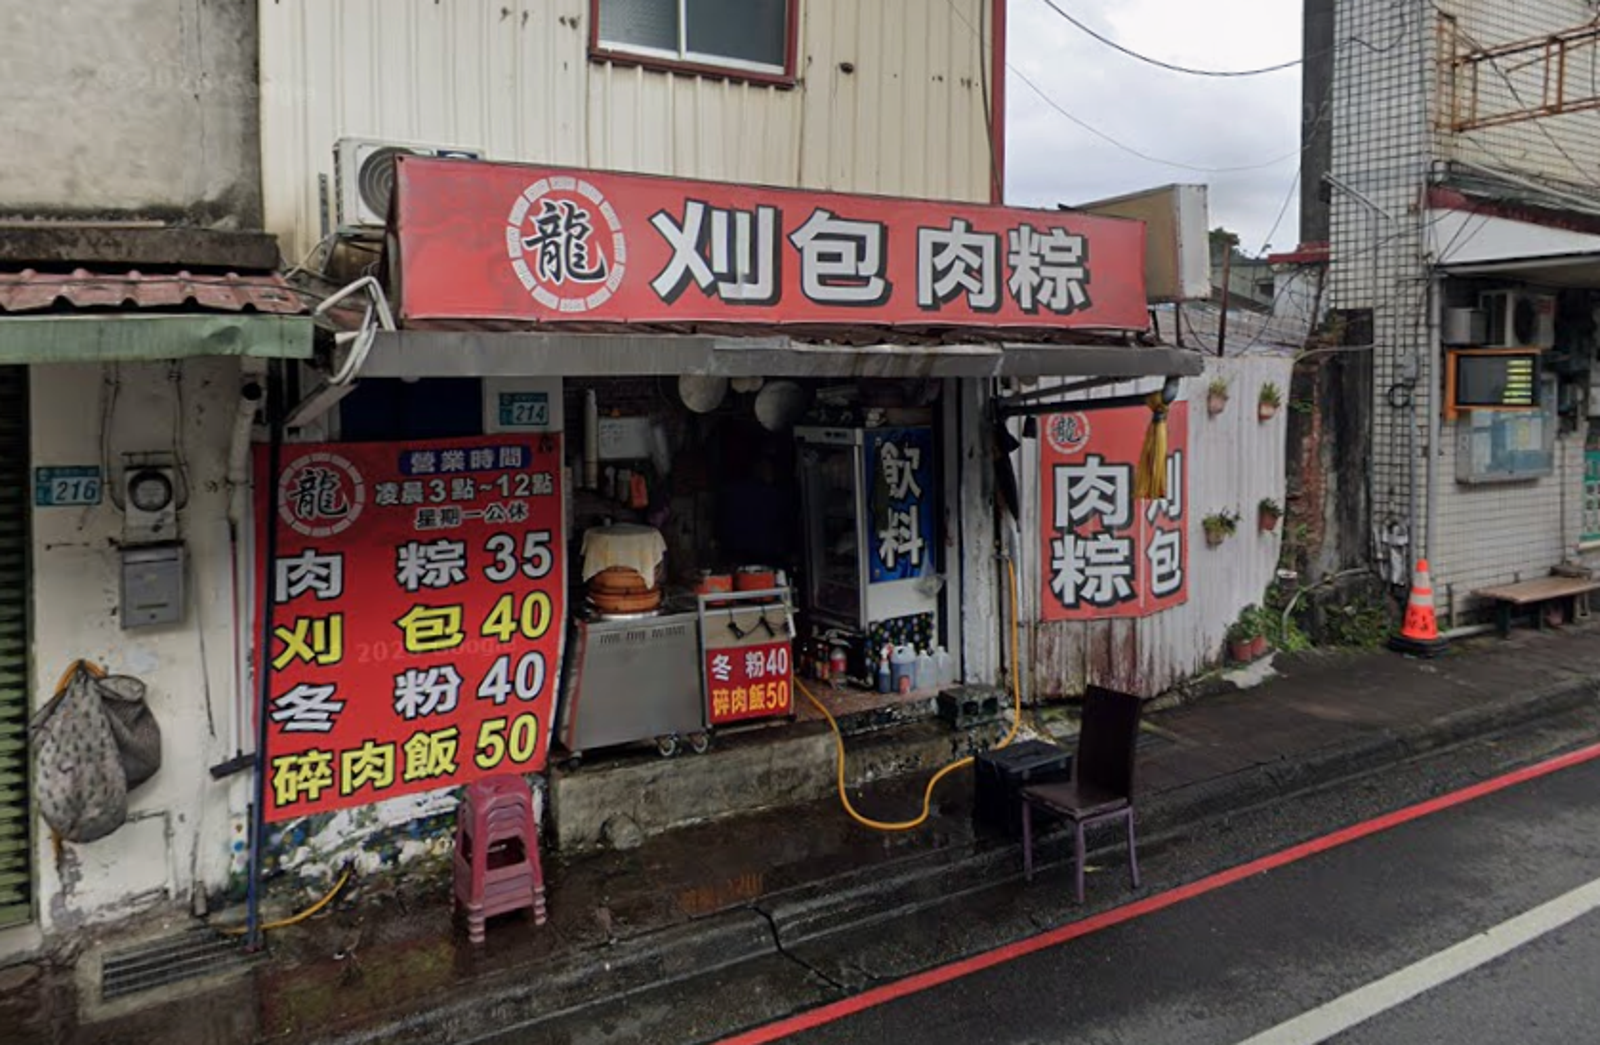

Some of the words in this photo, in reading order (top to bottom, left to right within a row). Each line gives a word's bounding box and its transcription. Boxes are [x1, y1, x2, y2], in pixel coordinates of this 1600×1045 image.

[521, 198, 608, 285] 龍
[650, 199, 889, 306] 刈包
[917, 219, 1090, 312] 肉粽
[516, 404, 545, 421] 214
[410, 446, 522, 474] 營業時間
[55, 480, 98, 501] 216
[285, 467, 350, 520] 龍
[414, 501, 529, 530] 星期一公休
[878, 441, 924, 569] 飲料
[484, 531, 552, 582] 35
[481, 590, 552, 642] 40
[478, 651, 546, 705] 40
[272, 728, 459, 806] 碎肉飯
[475, 713, 538, 769] 50
